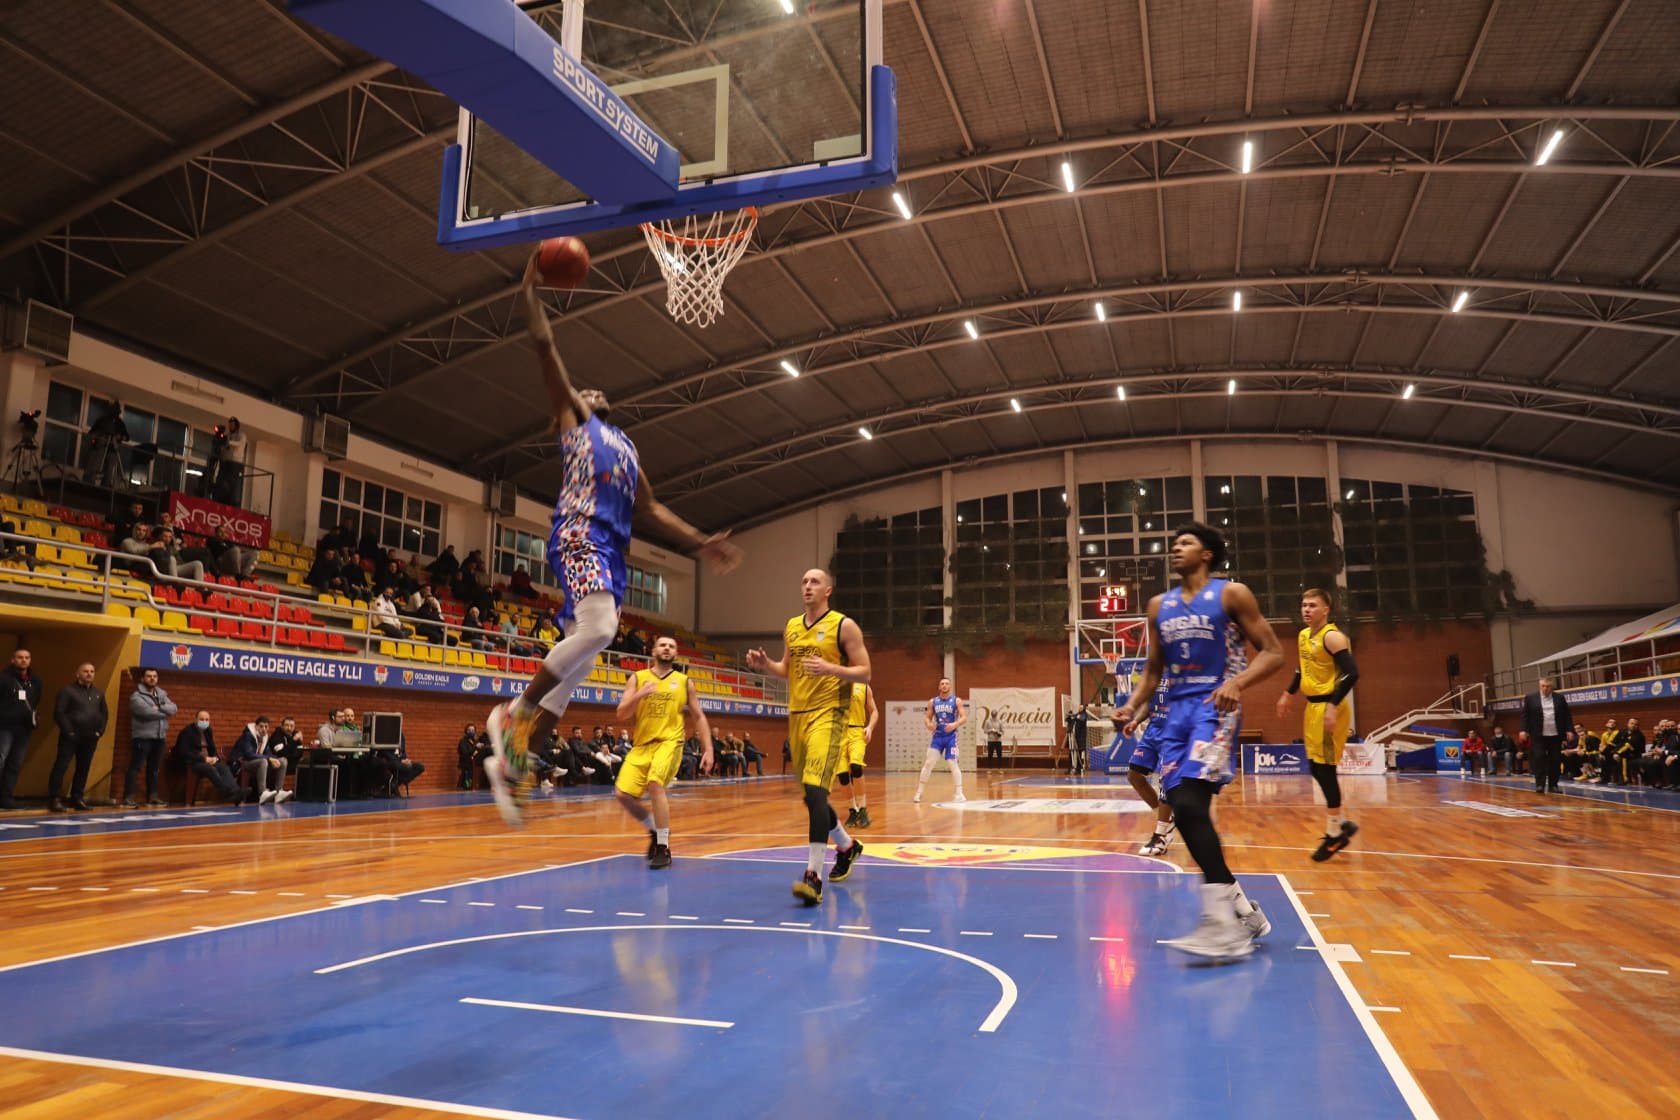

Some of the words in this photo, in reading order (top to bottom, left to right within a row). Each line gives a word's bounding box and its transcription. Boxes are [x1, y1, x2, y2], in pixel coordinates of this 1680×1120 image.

[553, 47, 605, 109] SPORT
[605, 98, 659, 158] SYSTEM
[191, 508, 262, 537] nexos
[1100, 598, 1118, 612] 21
[209, 652, 235, 669] K.B.
[239, 656, 294, 674] GOLDEN
[296, 661, 335, 677] EAGLE
[338, 665, 362, 680] YLLI
[414, 672, 434, 681] GOLDEN
[576, 688, 589, 699] YLLI
[976, 704, 1053, 729] Venecia
